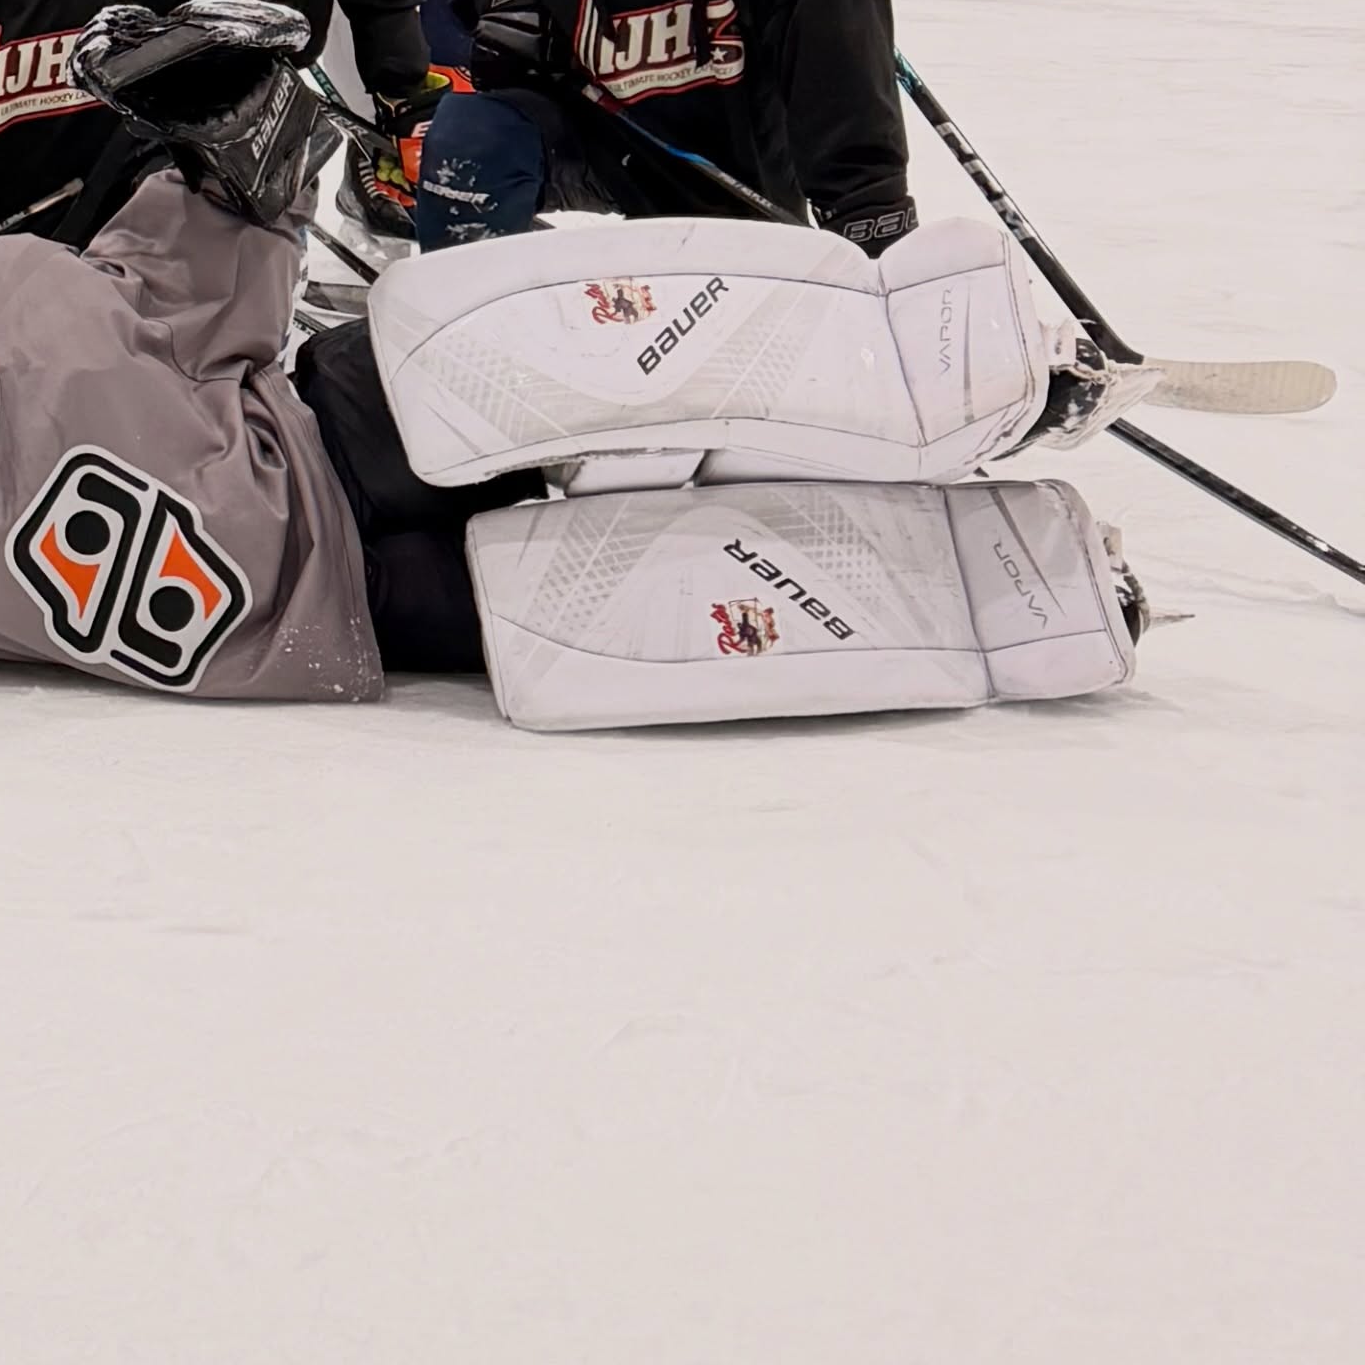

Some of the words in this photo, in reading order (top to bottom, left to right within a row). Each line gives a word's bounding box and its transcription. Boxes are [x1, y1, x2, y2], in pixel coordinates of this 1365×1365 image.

[636, 276, 730, 376] BAUER
[938, 287, 953, 376] VAPOR
[723, 538, 855, 641] BAUER
[993, 540, 1049, 630] VAPOR
